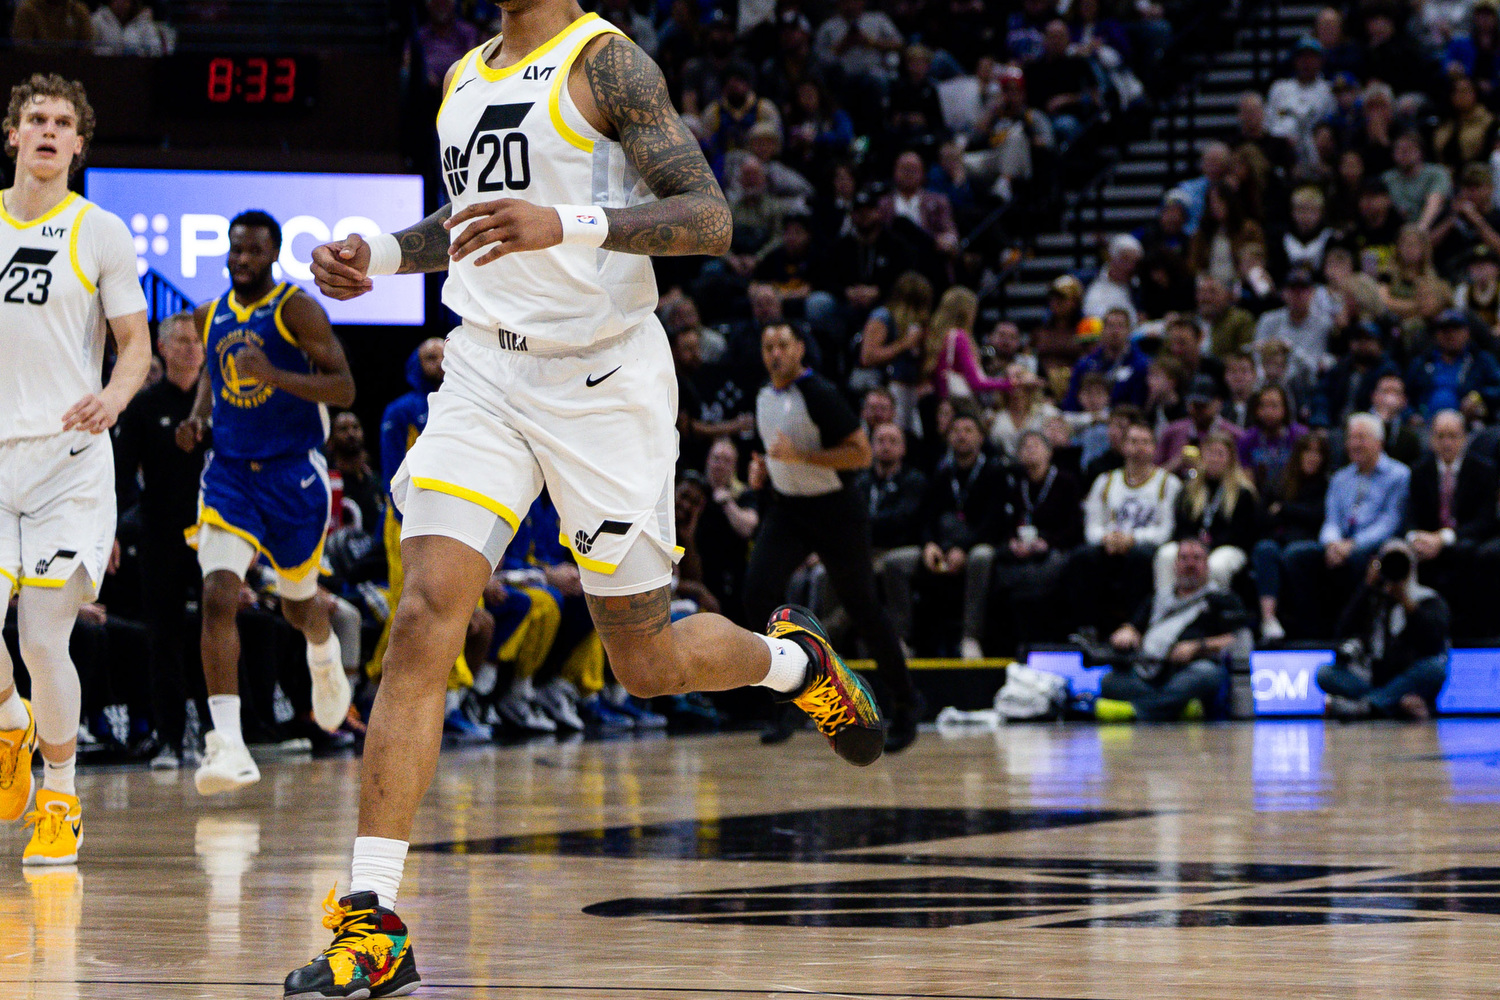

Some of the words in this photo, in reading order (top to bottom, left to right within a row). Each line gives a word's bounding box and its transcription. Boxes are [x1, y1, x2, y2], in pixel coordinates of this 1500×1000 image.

[207, 56, 297, 103] 8:33
[522, 65, 557, 81] LVT
[476, 131, 530, 193] 20
[41, 225, 68, 239] LVT
[4, 265, 53, 306] 23
